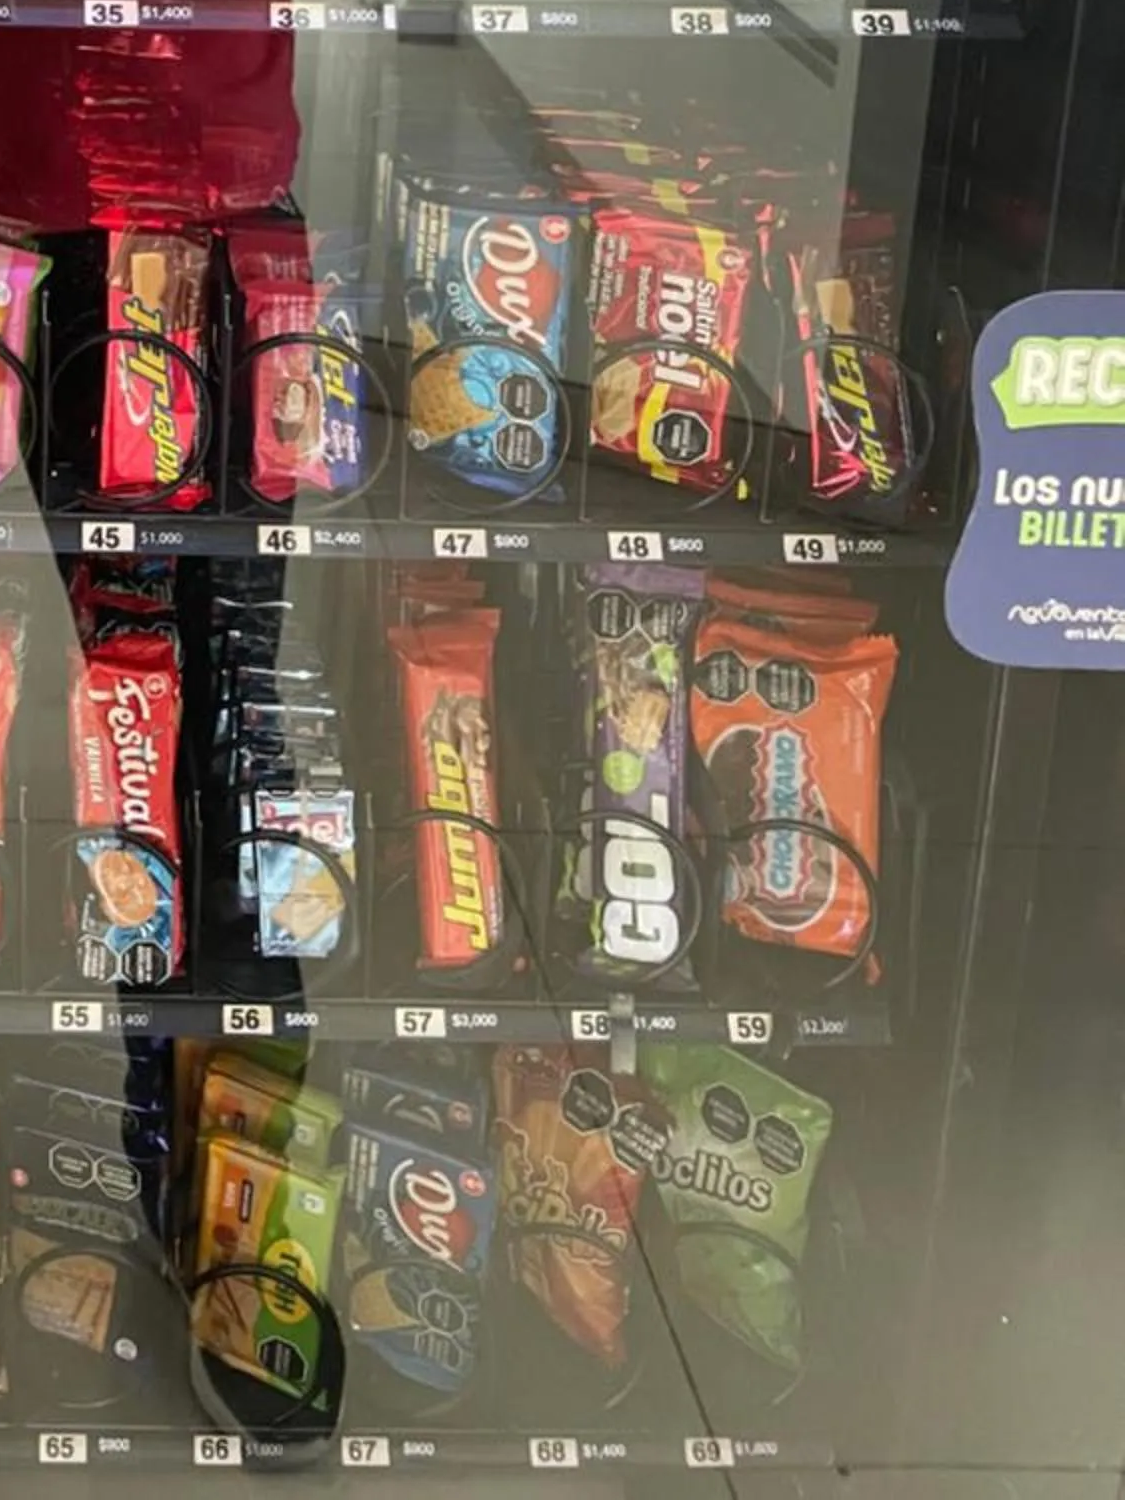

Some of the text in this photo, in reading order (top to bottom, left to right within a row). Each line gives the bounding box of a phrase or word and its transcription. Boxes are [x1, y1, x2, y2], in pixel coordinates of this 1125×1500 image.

[91, 4, 124, 24] 35
[142, 6, 190, 19] $1,400
[277, 8, 310, 27] 36
[329, 10, 377, 23] $1,000
[480, 11, 513, 29] 37
[679, 13, 712, 32] 38
[860, 15, 894, 33] 39
[480, 223, 548, 346] Dux
[1070, 475, 1125, 508] nu
[88, 528, 121, 548] 45
[141, 532, 183, 545] $1,000
[266, 531, 297, 550] 46
[441, 533, 473, 554] 47
[617, 536, 648, 557] 48
[792, 538, 824, 559] 49
[838, 538, 885, 553] $1,000
[87, 675, 167, 838] Festival
[84, 735, 104, 804] VAINILLA
[428, 740, 491, 951] Jumbo
[603, 793, 680, 964] GOL
[59, 1006, 89, 1027] 55
[230, 1008, 260, 1029] 56
[402, 1011, 433, 1032] 57
[580, 1016, 609, 1037] 58
[736, 1016, 766, 1037] 59
[406, 1169, 466, 1273] Dux
[46, 1438, 75, 1458] 65
[201, 1438, 229, 1459] 66
[348, 1440, 377, 1461] 67
[538, 1442, 566, 1462] 68
[693, 1441, 721, 1462] 69
